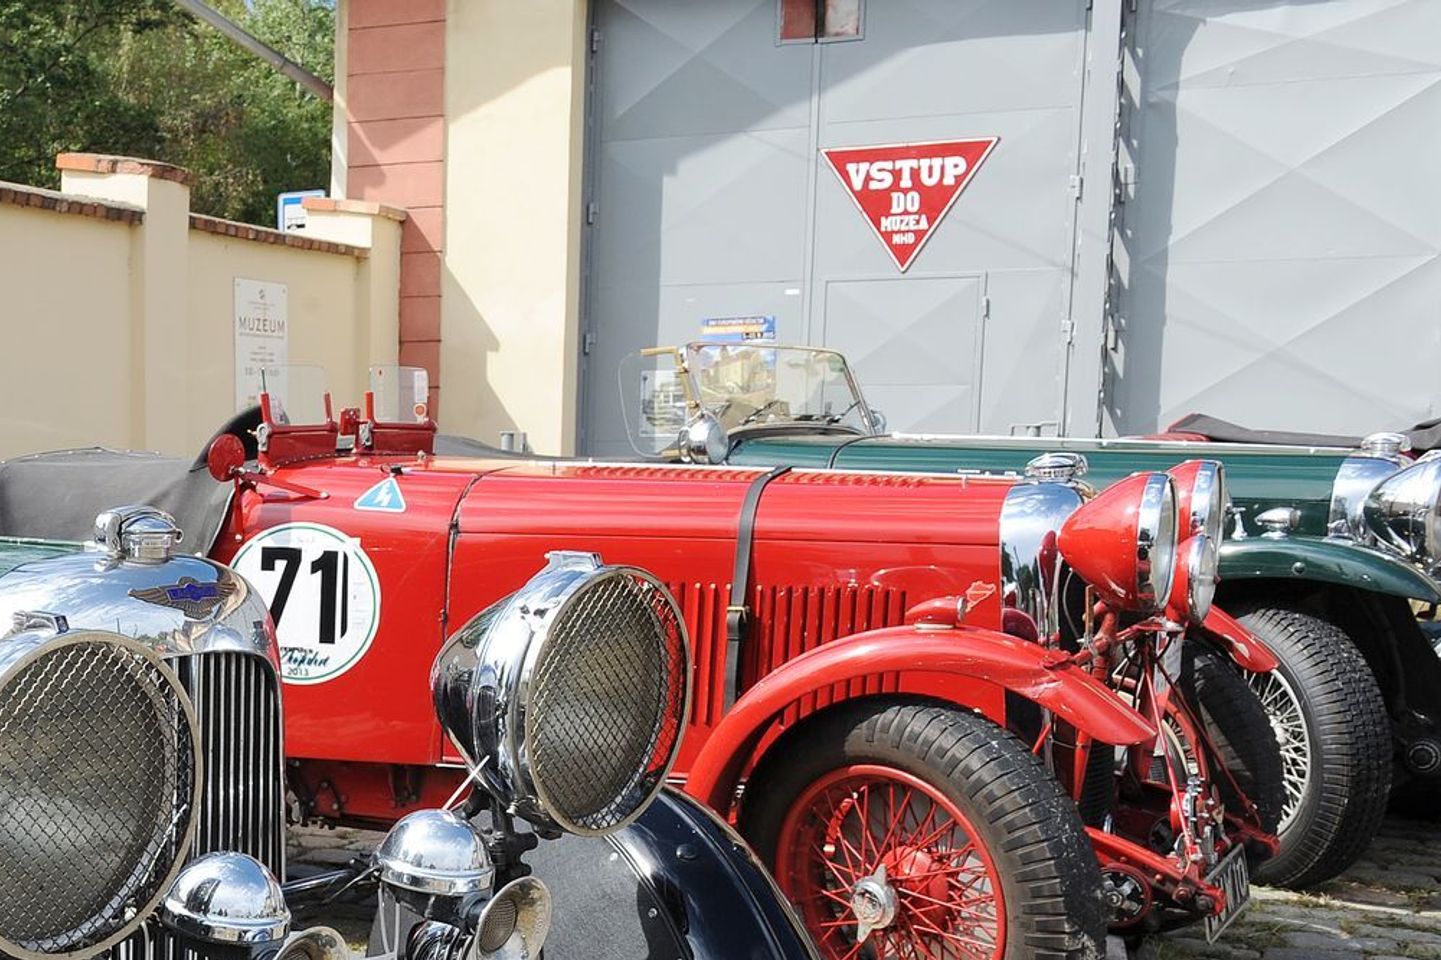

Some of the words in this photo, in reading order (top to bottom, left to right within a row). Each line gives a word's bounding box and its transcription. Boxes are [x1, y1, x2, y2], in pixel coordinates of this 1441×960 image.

[846, 155, 967, 191] VSTUP
[890, 191, 921, 214] DO
[880, 214, 929, 232] MUZEA
[239, 316, 286, 333] MUZEUM
[260, 546, 339, 645] 71
